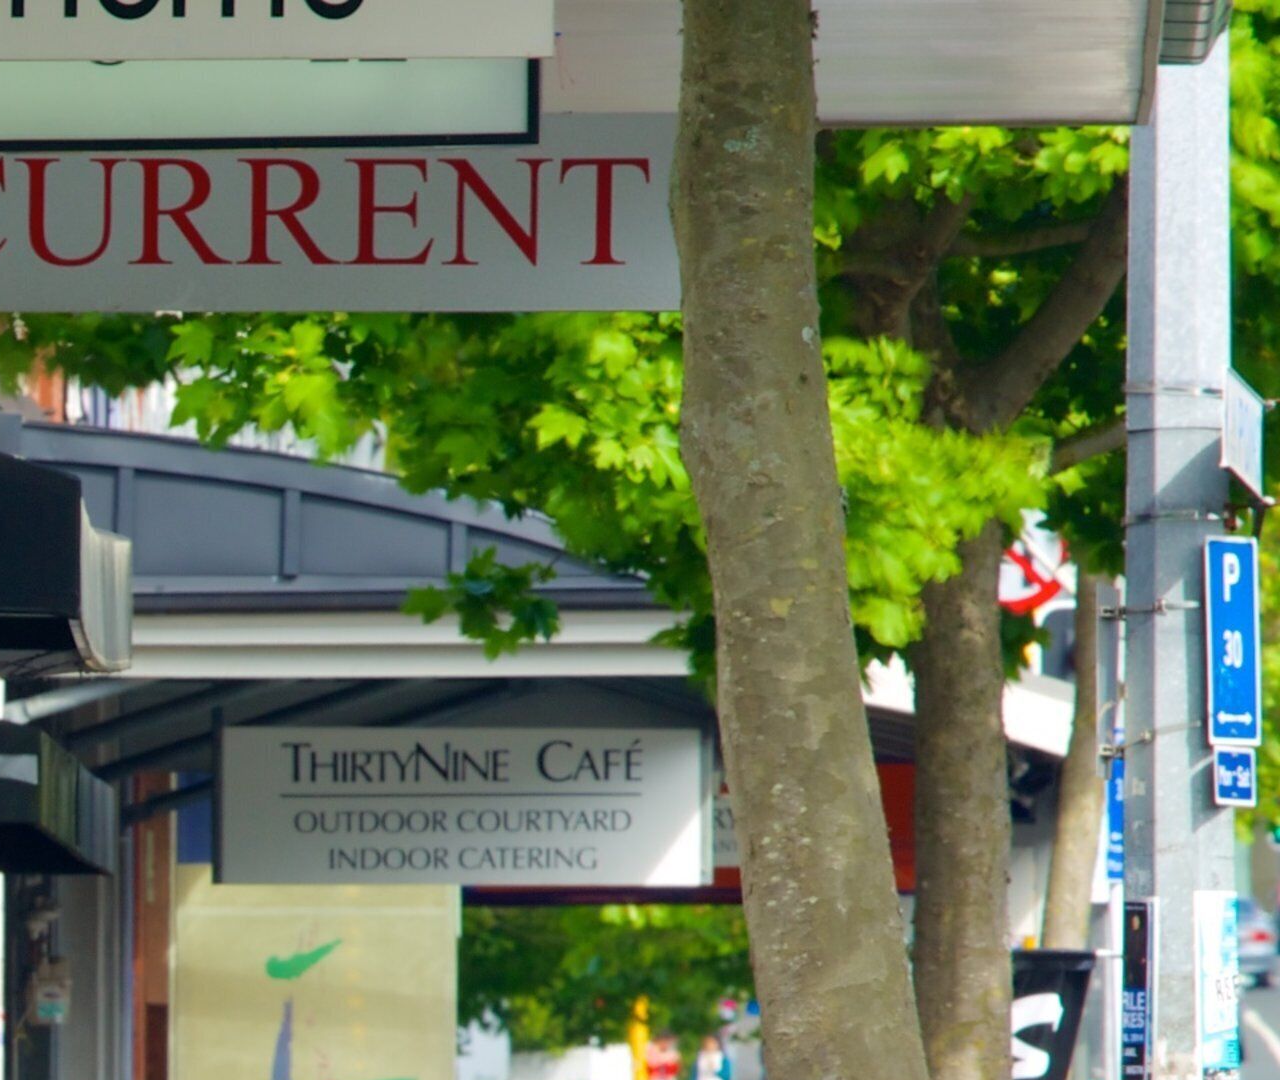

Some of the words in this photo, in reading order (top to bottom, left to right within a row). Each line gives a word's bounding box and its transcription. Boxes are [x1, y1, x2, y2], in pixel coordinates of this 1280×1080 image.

[1222, 552, 1240, 602] P
[1223, 629, 1243, 668] 30
[294, 809, 447, 834] OUTDOOR
[456, 808, 632, 832] COURTYARD
[328, 847, 449, 870] INDOOR
[458, 847, 598, 870] CATERING
